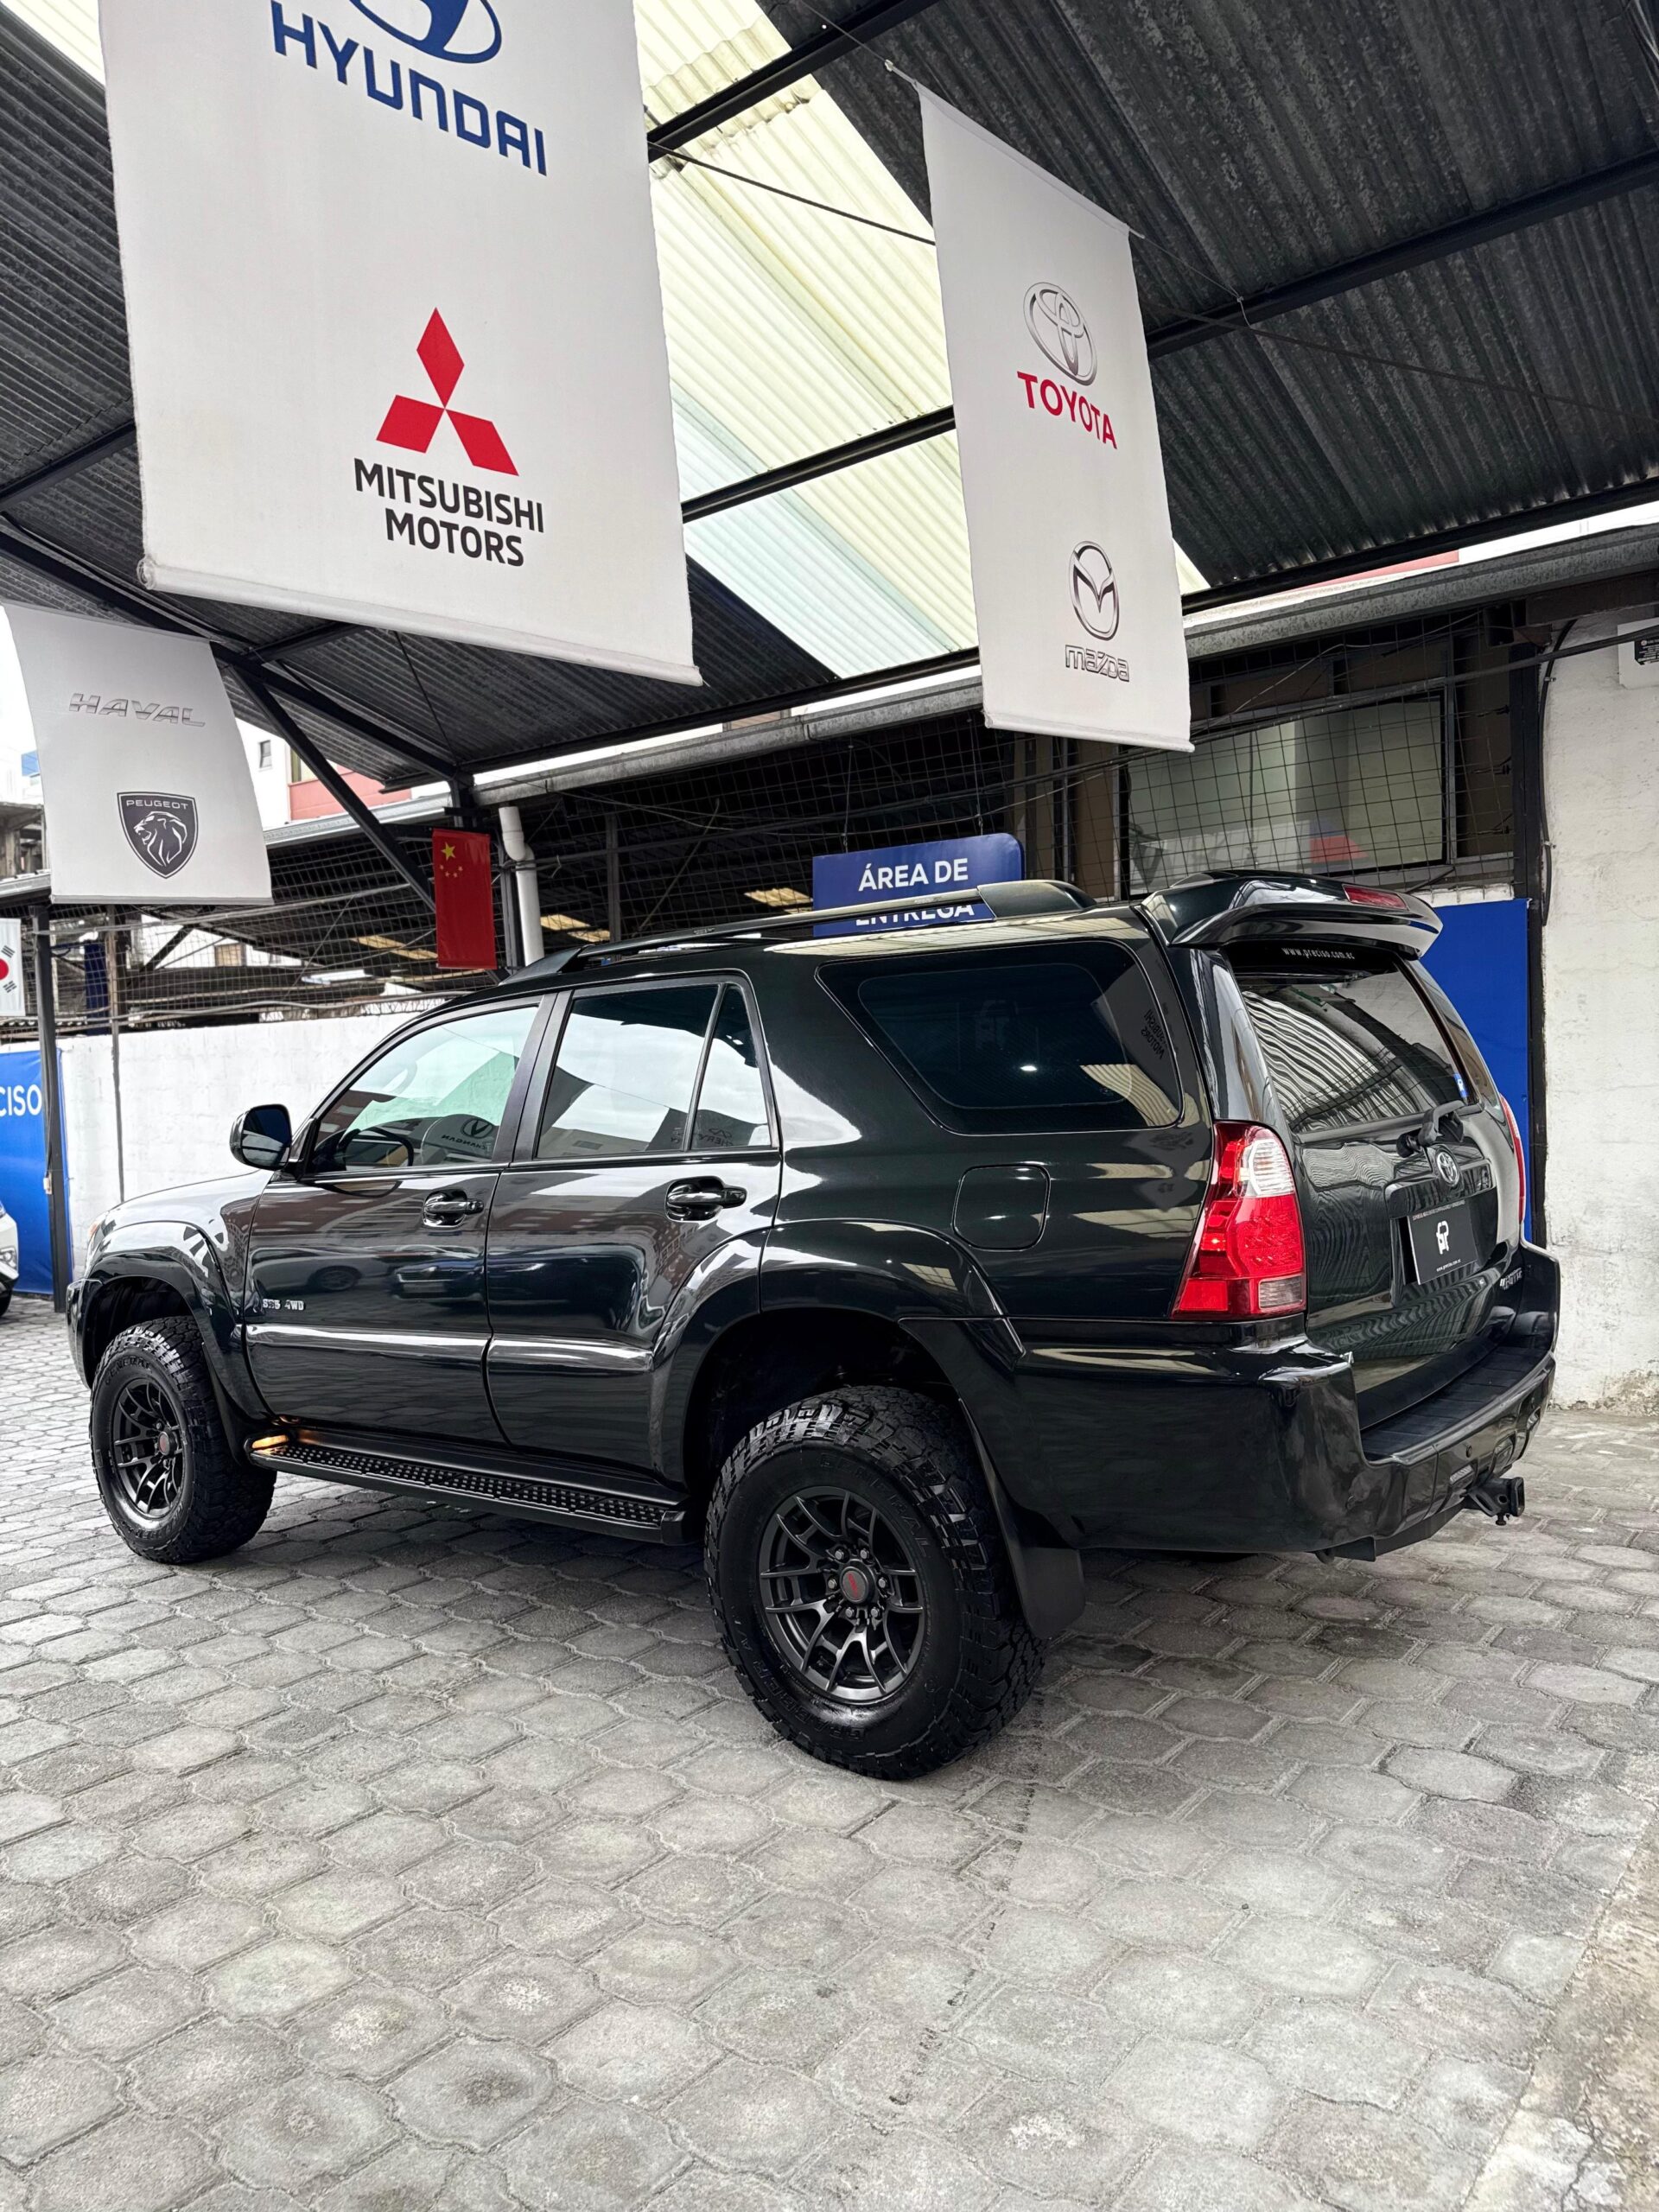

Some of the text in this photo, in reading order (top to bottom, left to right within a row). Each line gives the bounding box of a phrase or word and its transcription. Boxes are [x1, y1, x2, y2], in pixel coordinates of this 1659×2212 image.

[270, 0, 547, 176] HYUNDAI
[1017, 372, 1117, 449] TOYOTA
[354, 458, 543, 533] MITSUBISHI
[385, 508, 524, 567] MOTORS
[1065, 644, 1130, 683] mazda
[69, 692, 206, 727] HAVAL
[126, 799, 189, 810] PEUGEOT
[858, 858, 969, 892] ÁREA DE
[284, 1299, 305, 1311] 4WD
